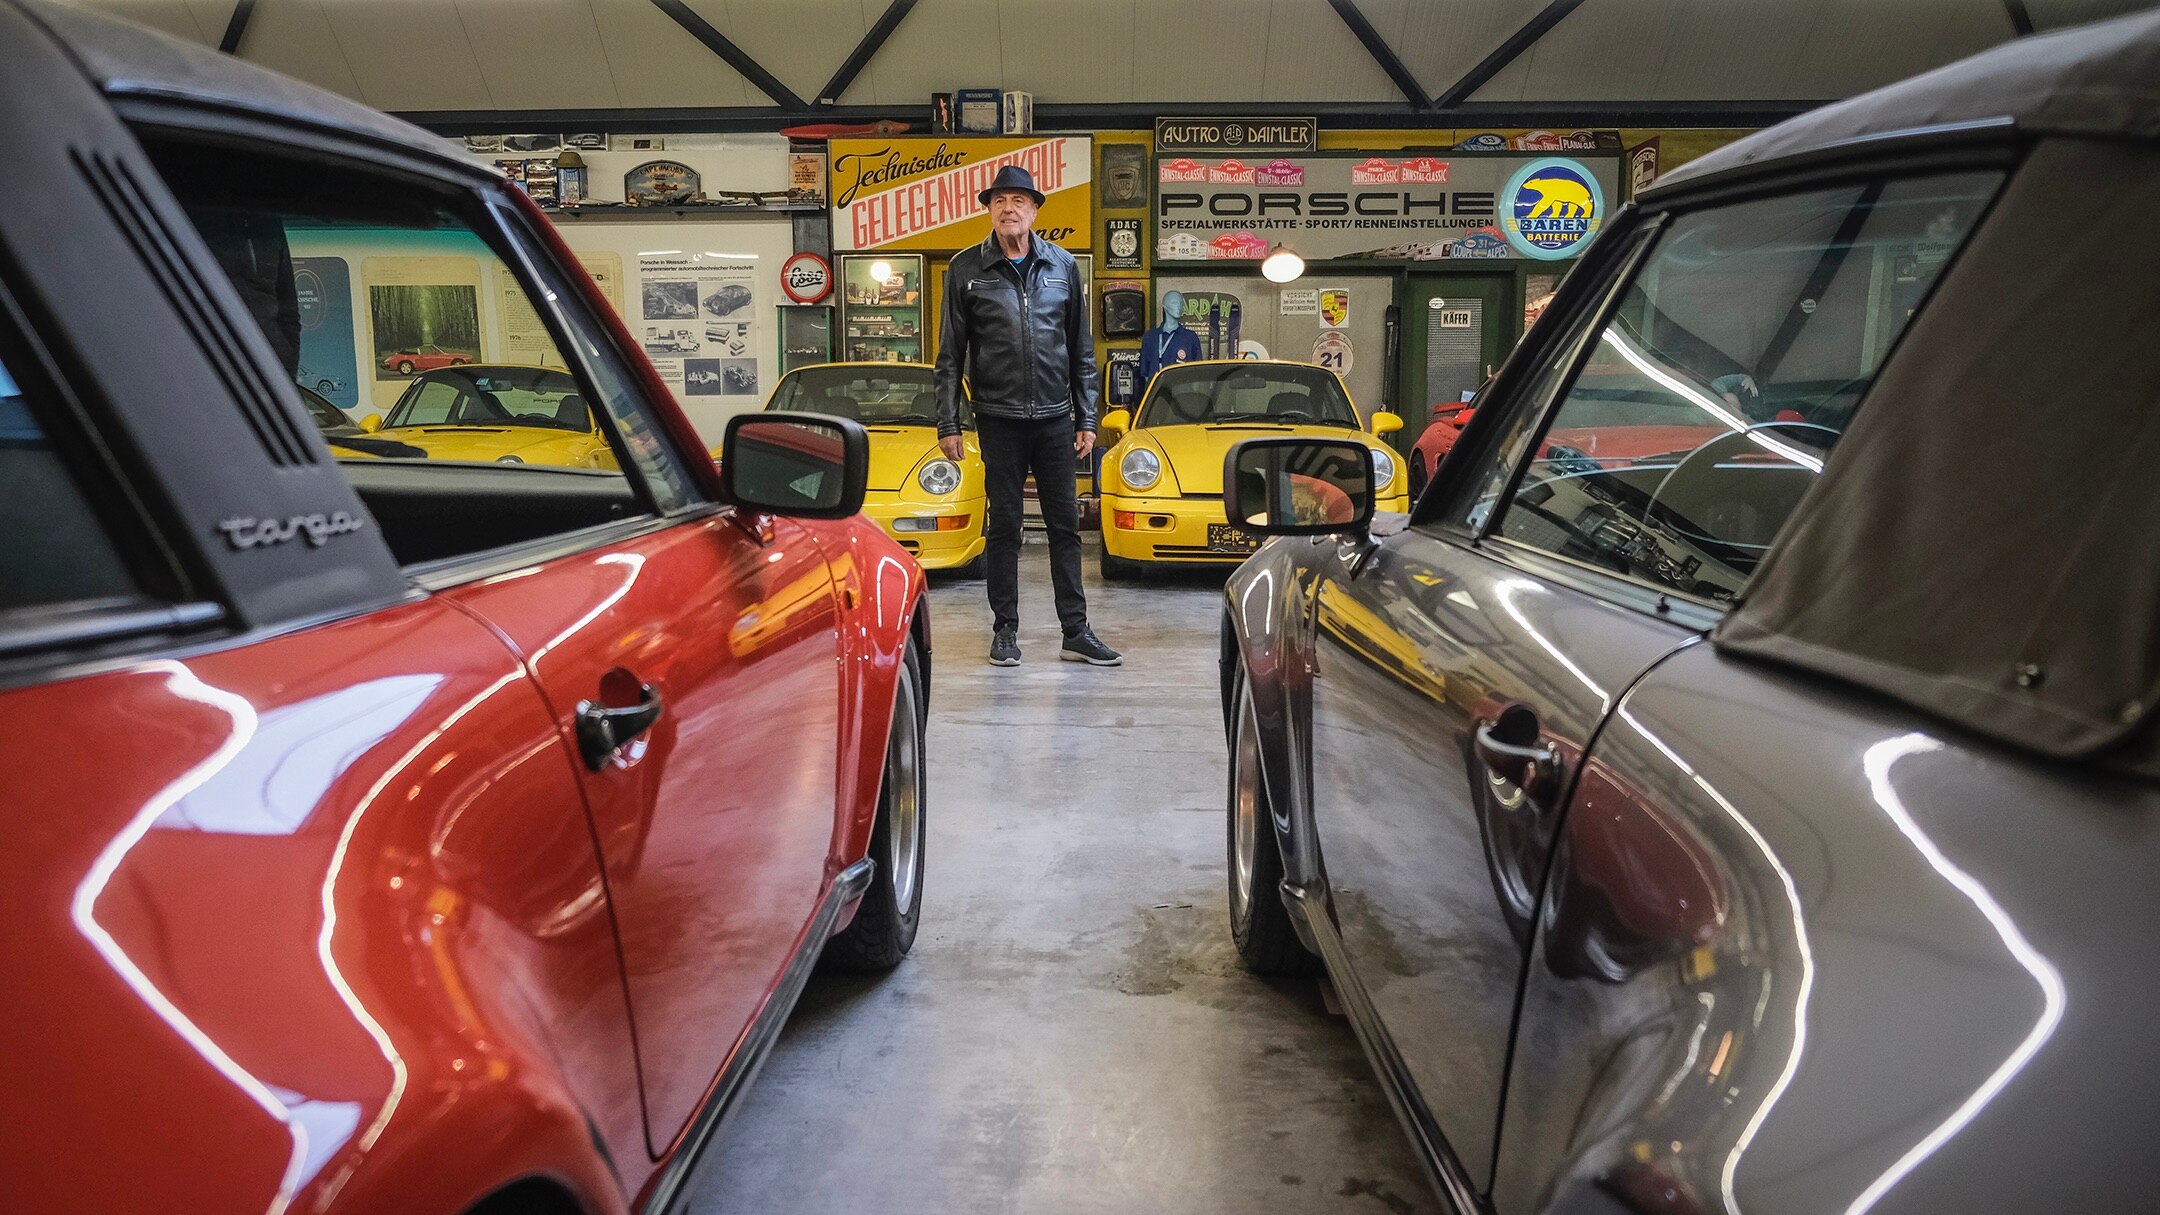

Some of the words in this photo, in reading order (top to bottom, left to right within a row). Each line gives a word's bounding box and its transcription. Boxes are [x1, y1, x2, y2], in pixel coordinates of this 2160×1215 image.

[1163, 127, 1220, 143] AUSTRO
[1248, 126, 1308, 143] DAIMLER
[835, 143, 967, 209] Technischer
[1161, 167, 1205, 181] ENNSTAL-CLASSIC
[1210, 167, 1254, 182] ENNSTAL-CLASSIC
[1258, 172, 1302, 185] ENNSTAL-CLASSIC
[1354, 168, 1398, 183] ENNSTAL-CLASSIC
[1402, 168, 1447, 182] ENNSTAL-CLASSIC
[852, 138, 1066, 249] GELEGENHEITAUF
[1161, 193, 1494, 216] PORSCHE
[1110, 221, 1138, 229] ADAC
[1161, 218, 1297, 230] SPEZIALWERKSTÄTTE
[1305, 218, 1494, 230] SPORT/RENNEINSTELLUNGEN
[1520, 218, 1588, 231] BÄREN
[1526, 233, 1580, 241] BATTERIE
[1178, 247, 1190, 255] 105
[1208, 244, 1249, 258] NNSTAL-CLASSIC
[1453, 244, 1472, 258] COUPE
[1487, 244, 1508, 258] ALPES
[790, 267, 823, 288] Esso
[1443, 311, 1468, 325] KÄFER
[1320, 352, 1343, 368] 21
[218, 510, 365, 548] targa
